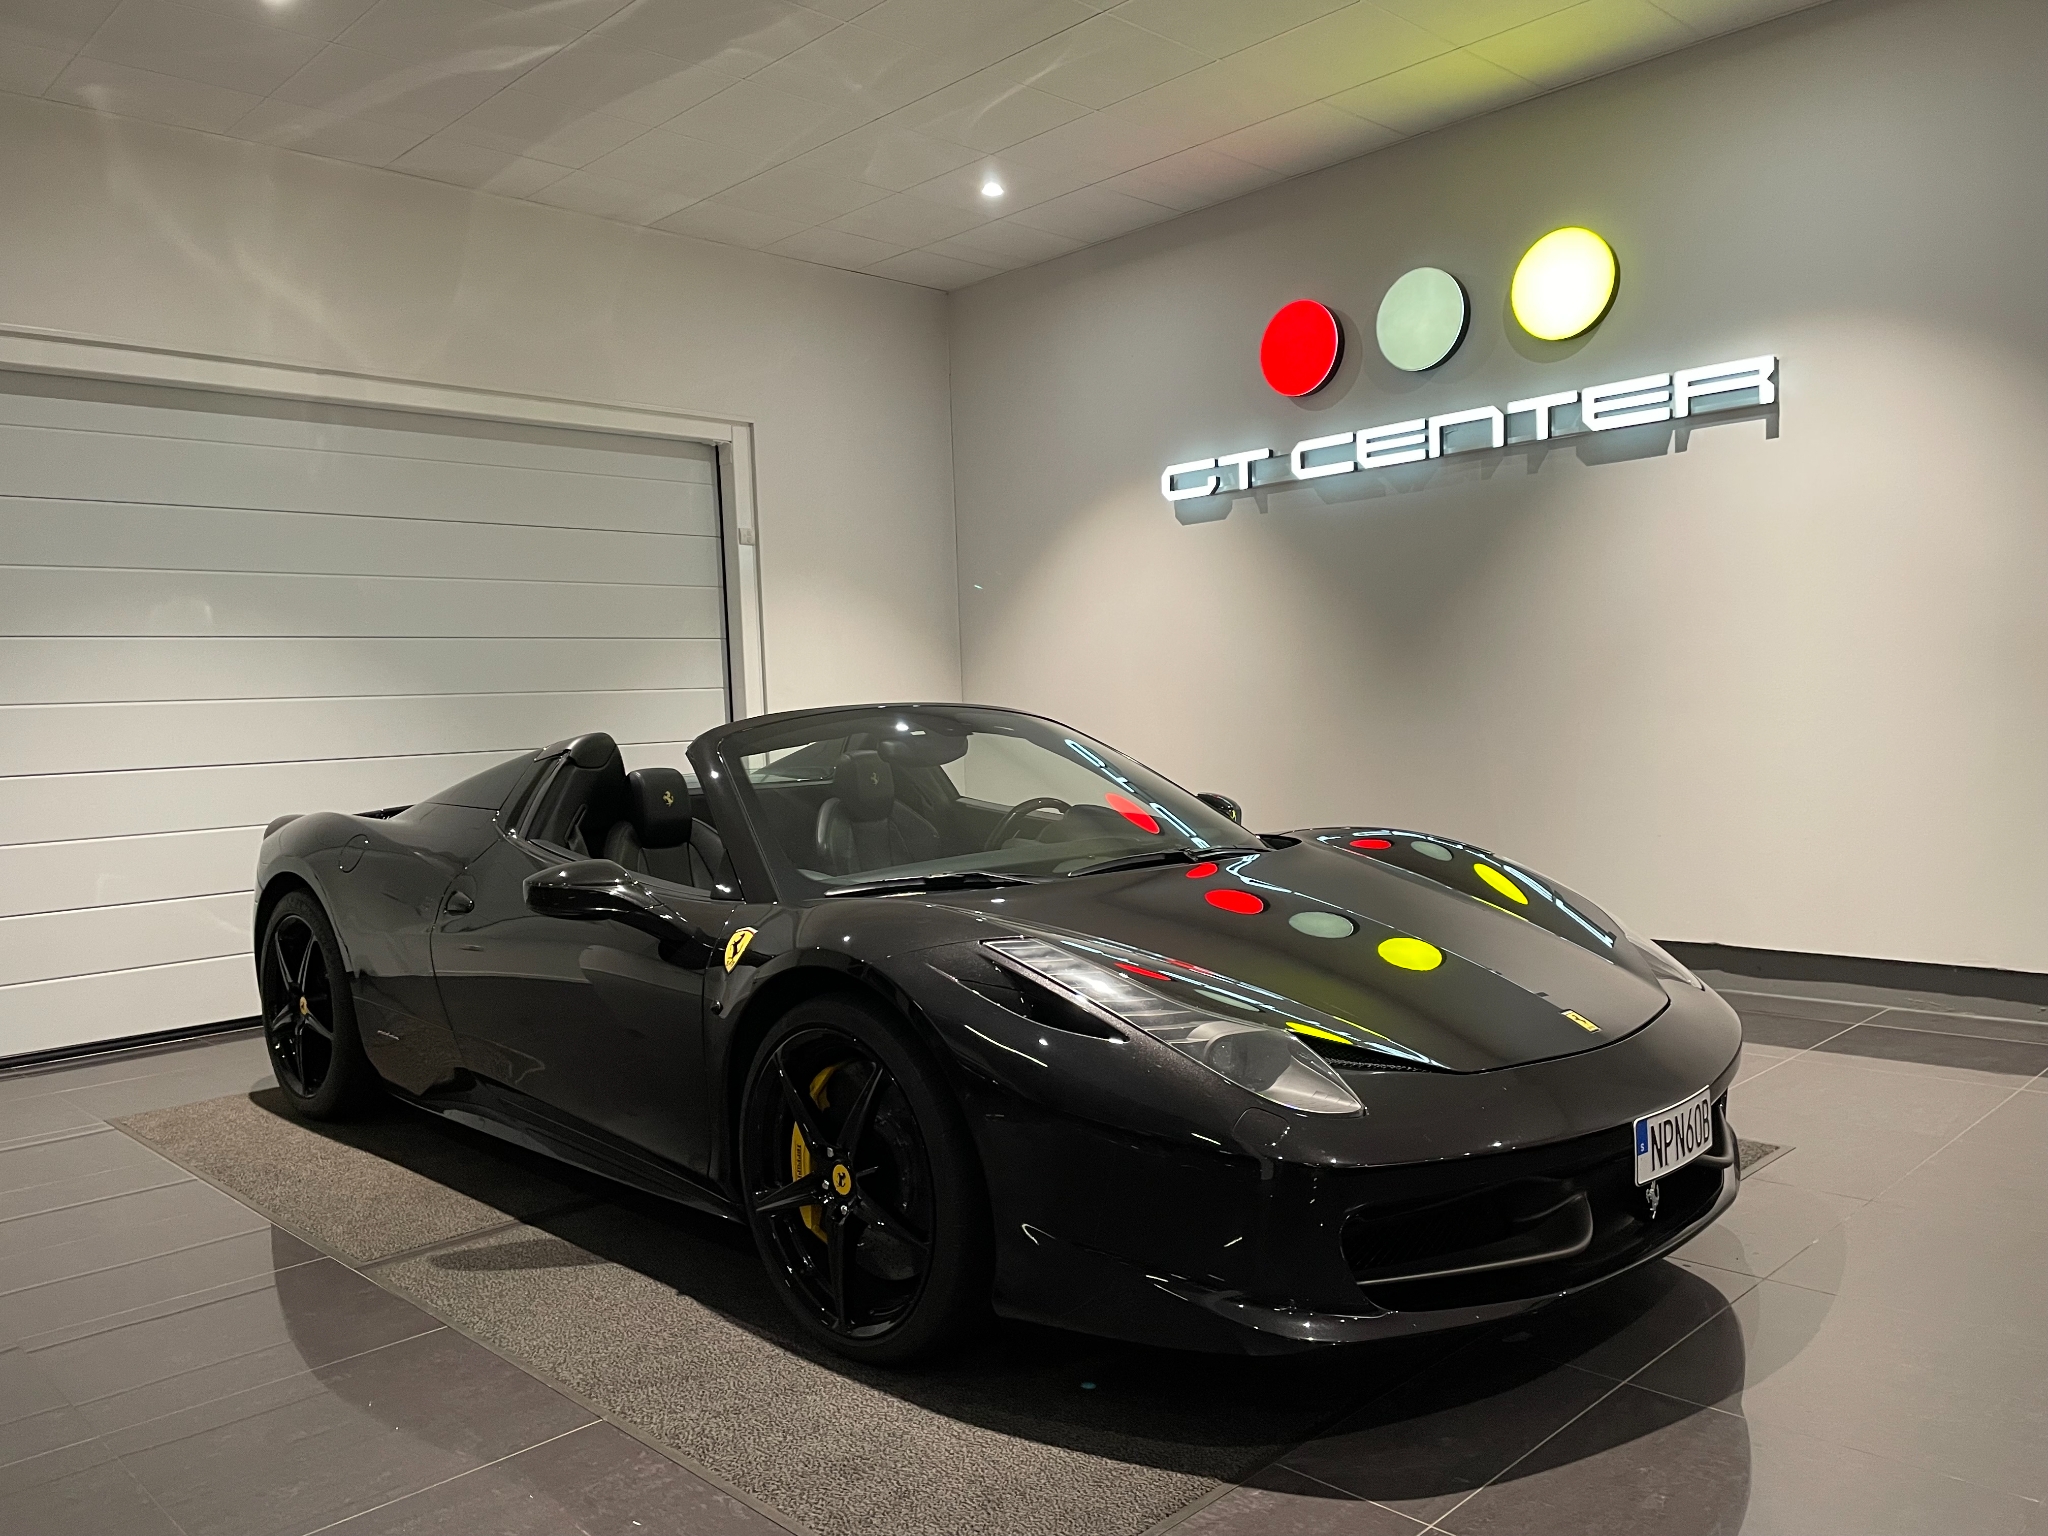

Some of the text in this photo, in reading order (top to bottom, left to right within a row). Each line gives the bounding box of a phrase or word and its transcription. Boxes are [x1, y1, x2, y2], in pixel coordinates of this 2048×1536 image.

[1161, 355, 1777, 501] GT CENTER
[1640, 1142, 1646, 1152] S
[1650, 1098, 1710, 1172] NPN60B
